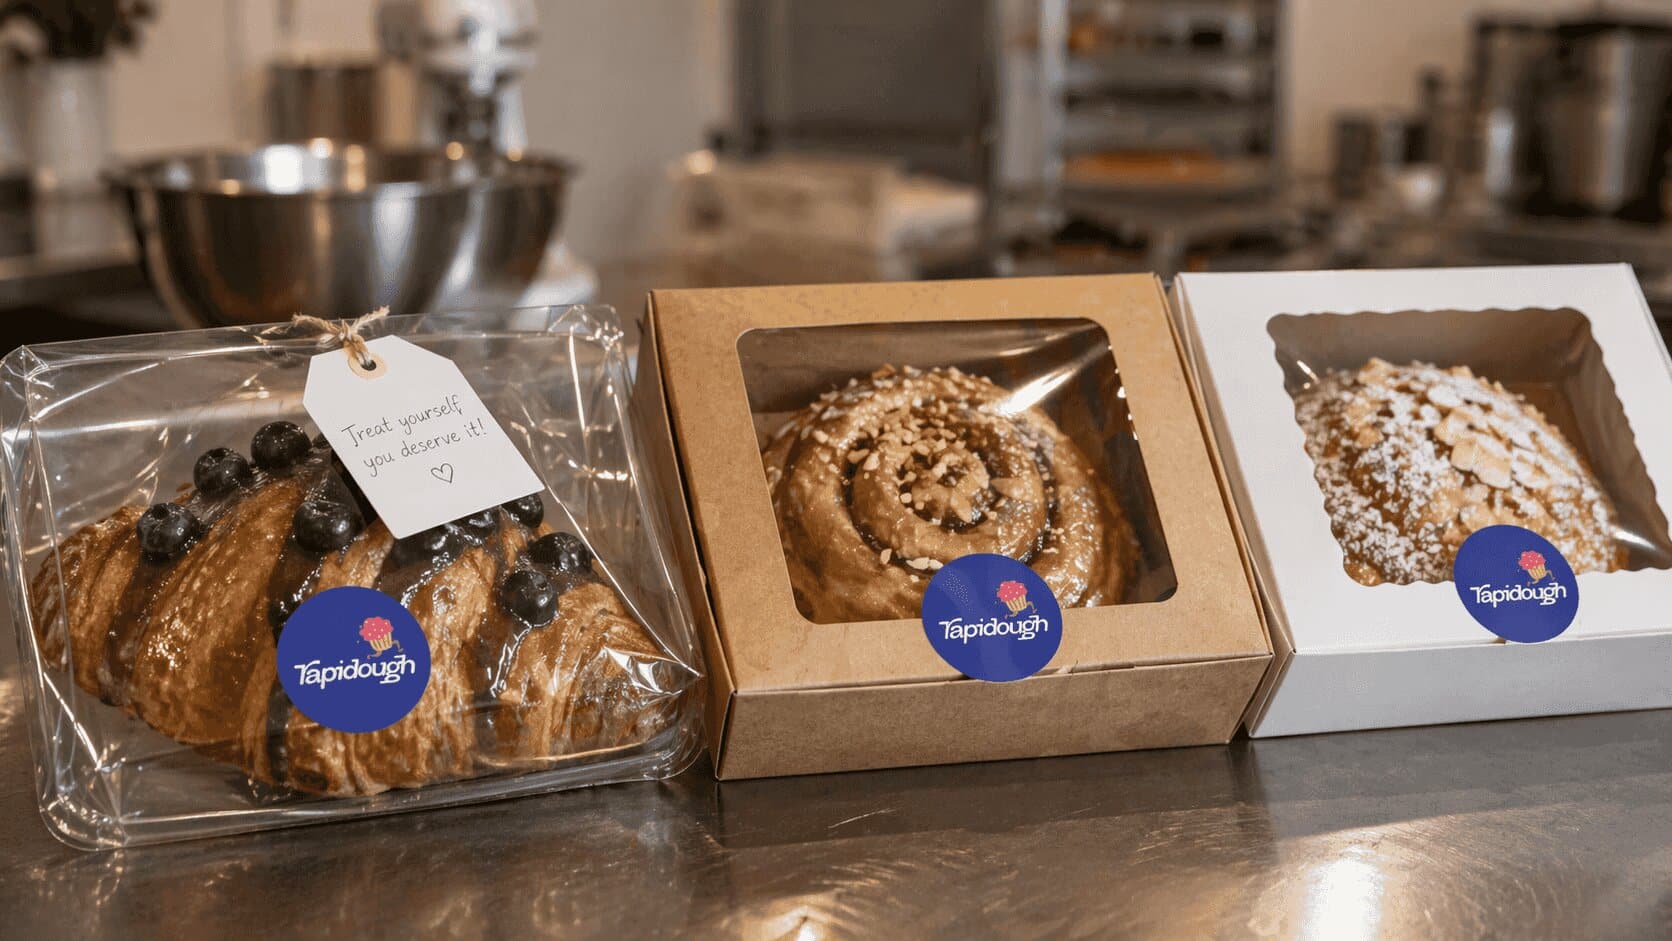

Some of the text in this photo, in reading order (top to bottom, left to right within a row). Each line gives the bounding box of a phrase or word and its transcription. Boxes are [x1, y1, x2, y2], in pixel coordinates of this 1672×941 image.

[341, 417, 393, 447] Treat
[363, 417, 487, 478] you deserve it!
[1469, 582, 1567, 608] Tapidough
[938, 614, 1049, 644] Tapidough
[294, 654, 416, 690] Tapidough
